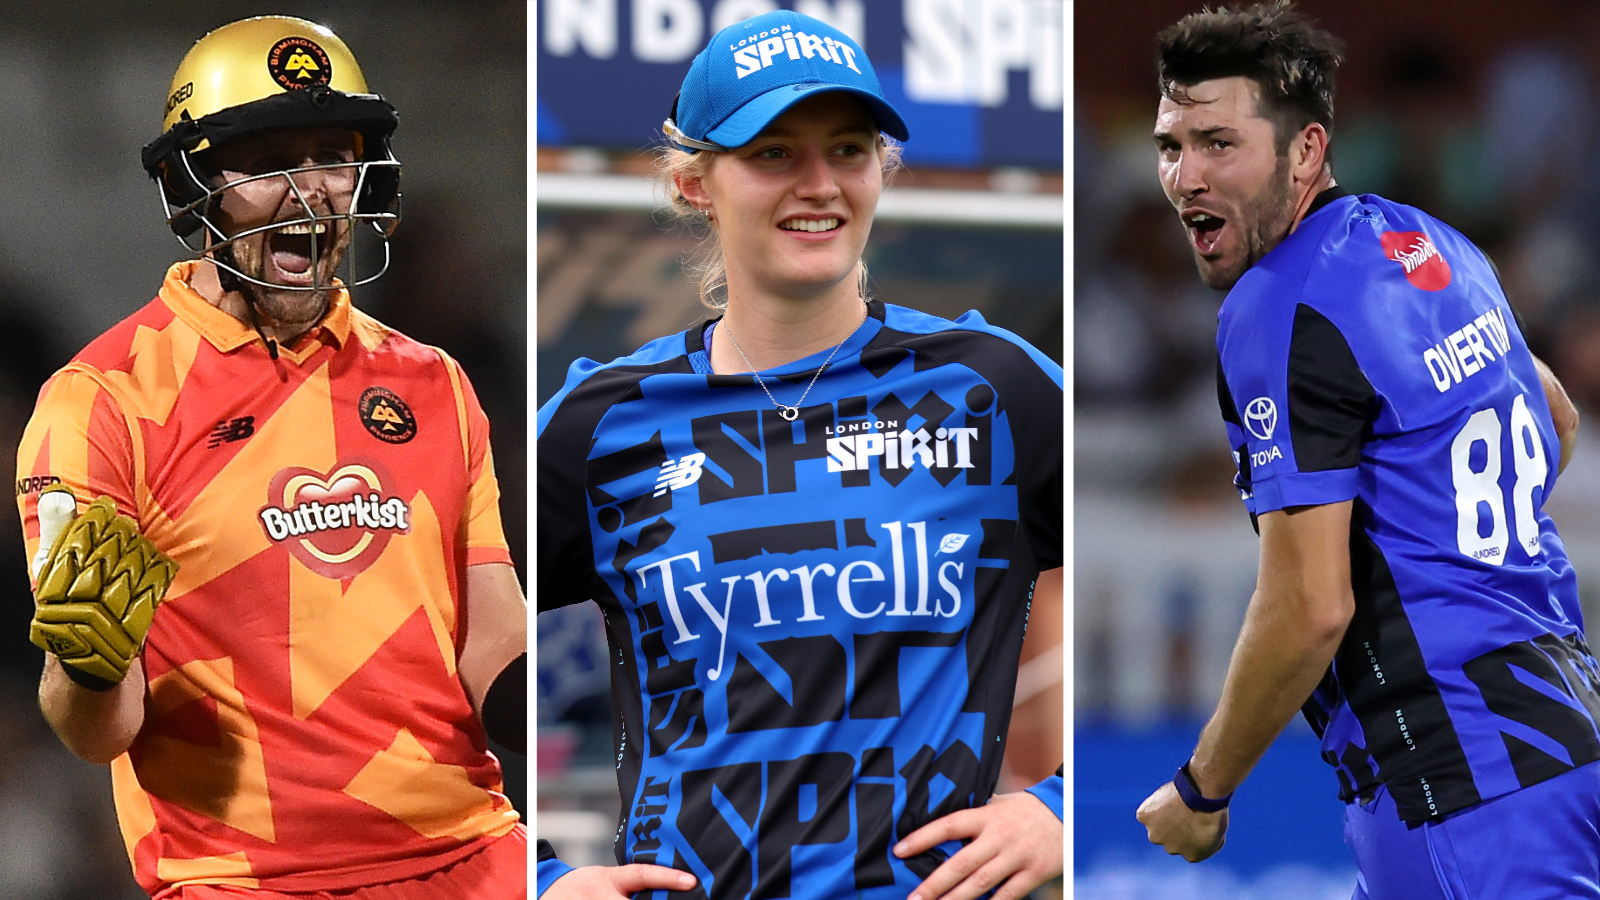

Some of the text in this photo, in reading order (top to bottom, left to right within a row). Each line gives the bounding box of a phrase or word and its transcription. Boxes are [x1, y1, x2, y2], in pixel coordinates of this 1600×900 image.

[270, 39, 330, 66] BIRMINGHAM
[730, 24, 791, 51] LONDON
[164, 81, 194, 118] DRED
[825, 419, 898, 435] LONDON
[1451, 393, 1548, 566] 88
[262, 493, 410, 541] Butterkist
[1022, 580, 1035, 640] ONDON
[1364, 641, 1386, 685] LONDON
[1395, 709, 1416, 751] LONDON
[1420, 777, 1438, 816] LONDON
